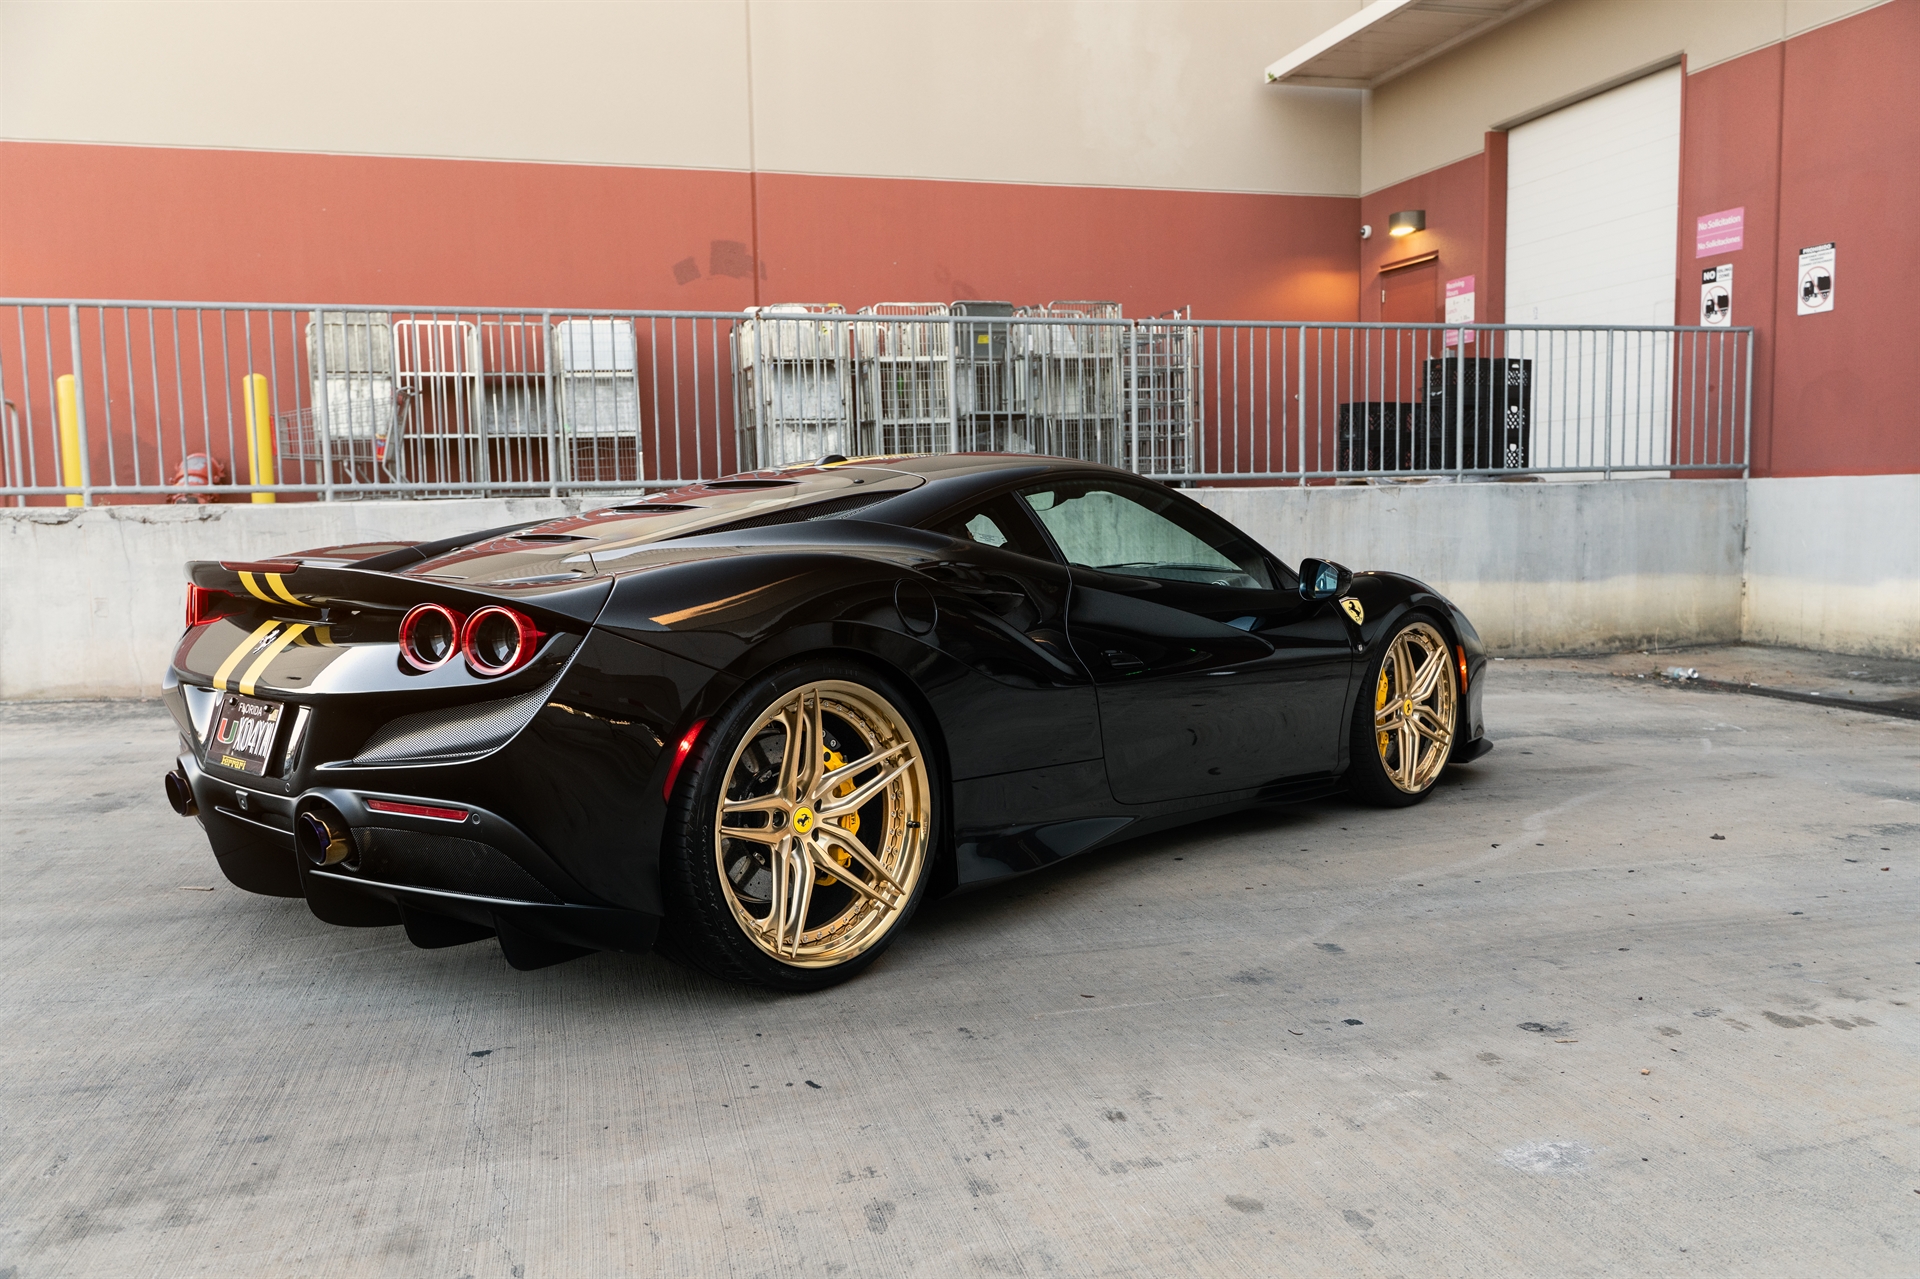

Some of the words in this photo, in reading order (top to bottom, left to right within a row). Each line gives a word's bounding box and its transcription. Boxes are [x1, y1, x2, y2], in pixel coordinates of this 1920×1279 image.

[1698, 222, 1707, 231] No
[1707, 215, 1741, 229] Solicitation
[1697, 242, 1705, 250] No
[1703, 270, 1715, 281] NO
[238, 702, 263, 716] FLORIDA
